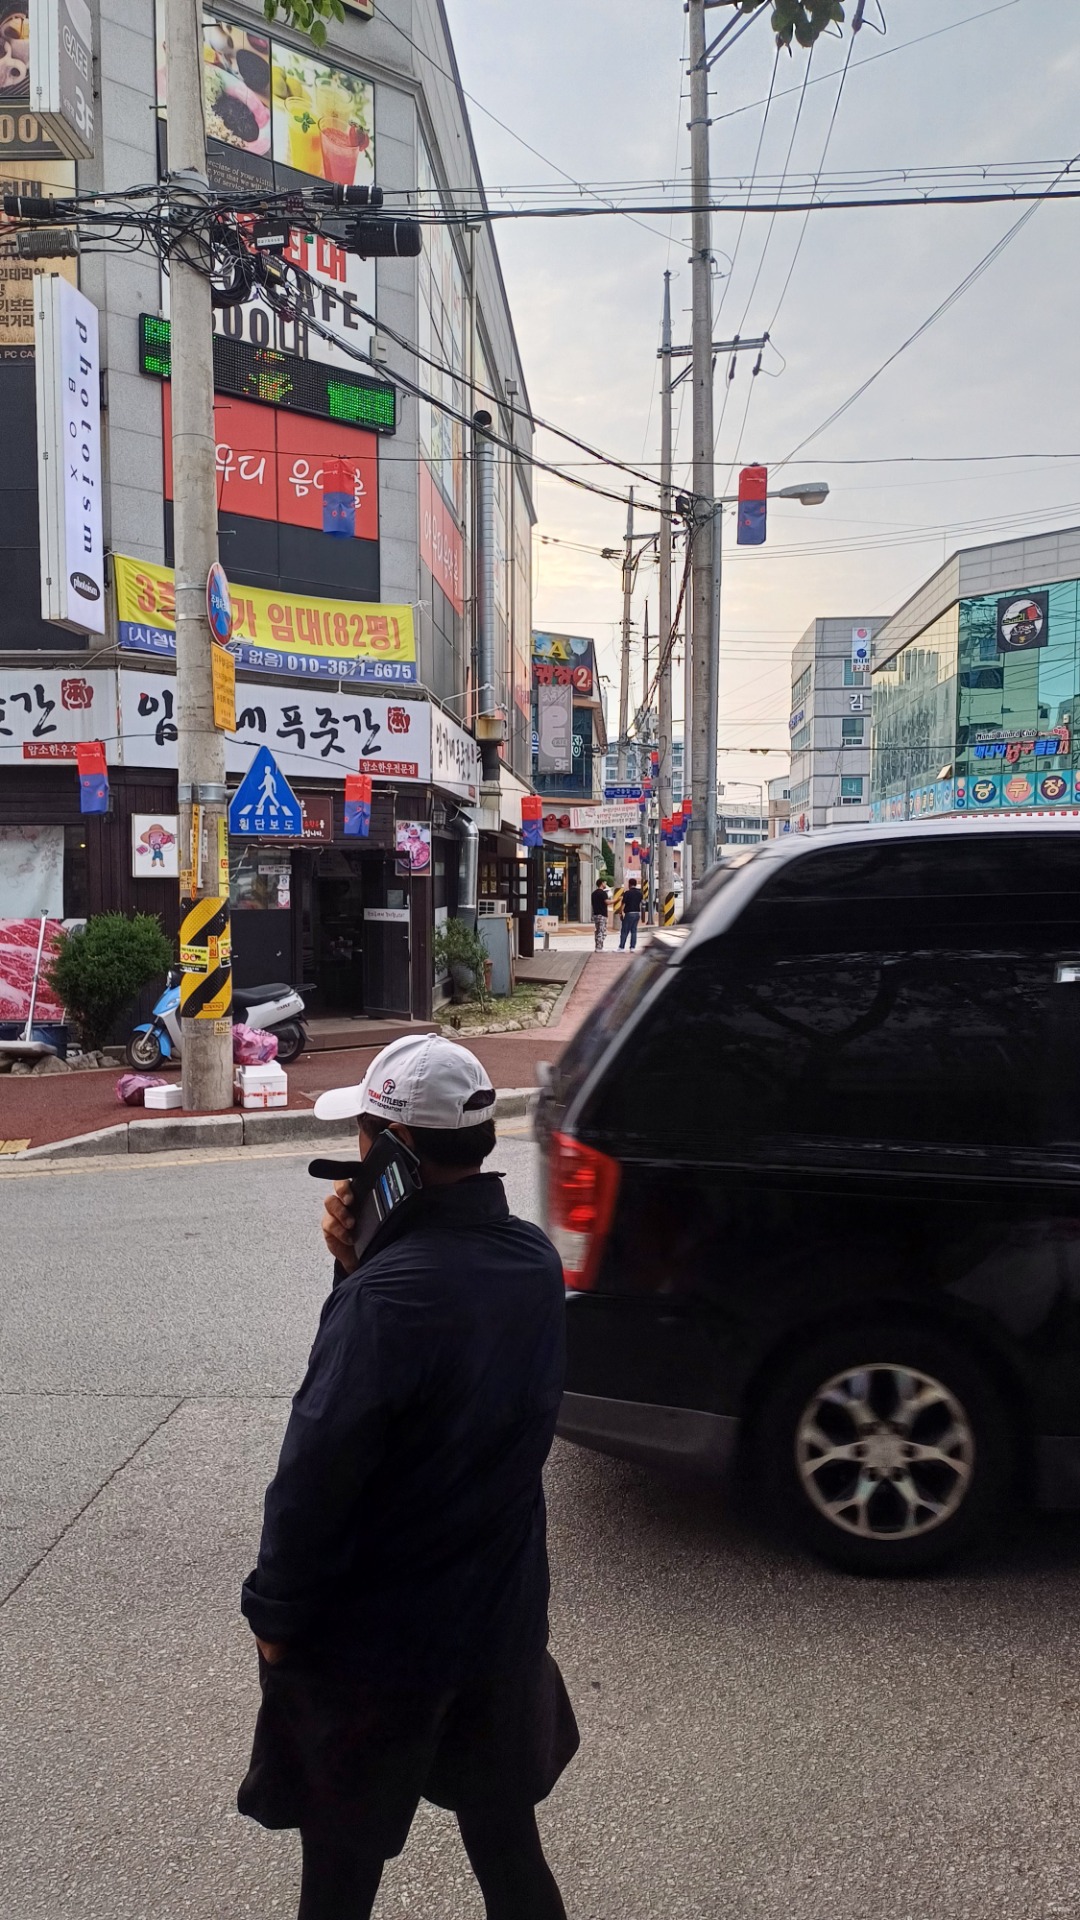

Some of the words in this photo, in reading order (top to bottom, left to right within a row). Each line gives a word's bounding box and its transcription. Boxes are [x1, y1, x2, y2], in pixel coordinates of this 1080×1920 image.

[75, 86, 94, 139] 3F
[4, 350, 17, 359] PC
[287, 654, 413, 680] 010-3671-6675
